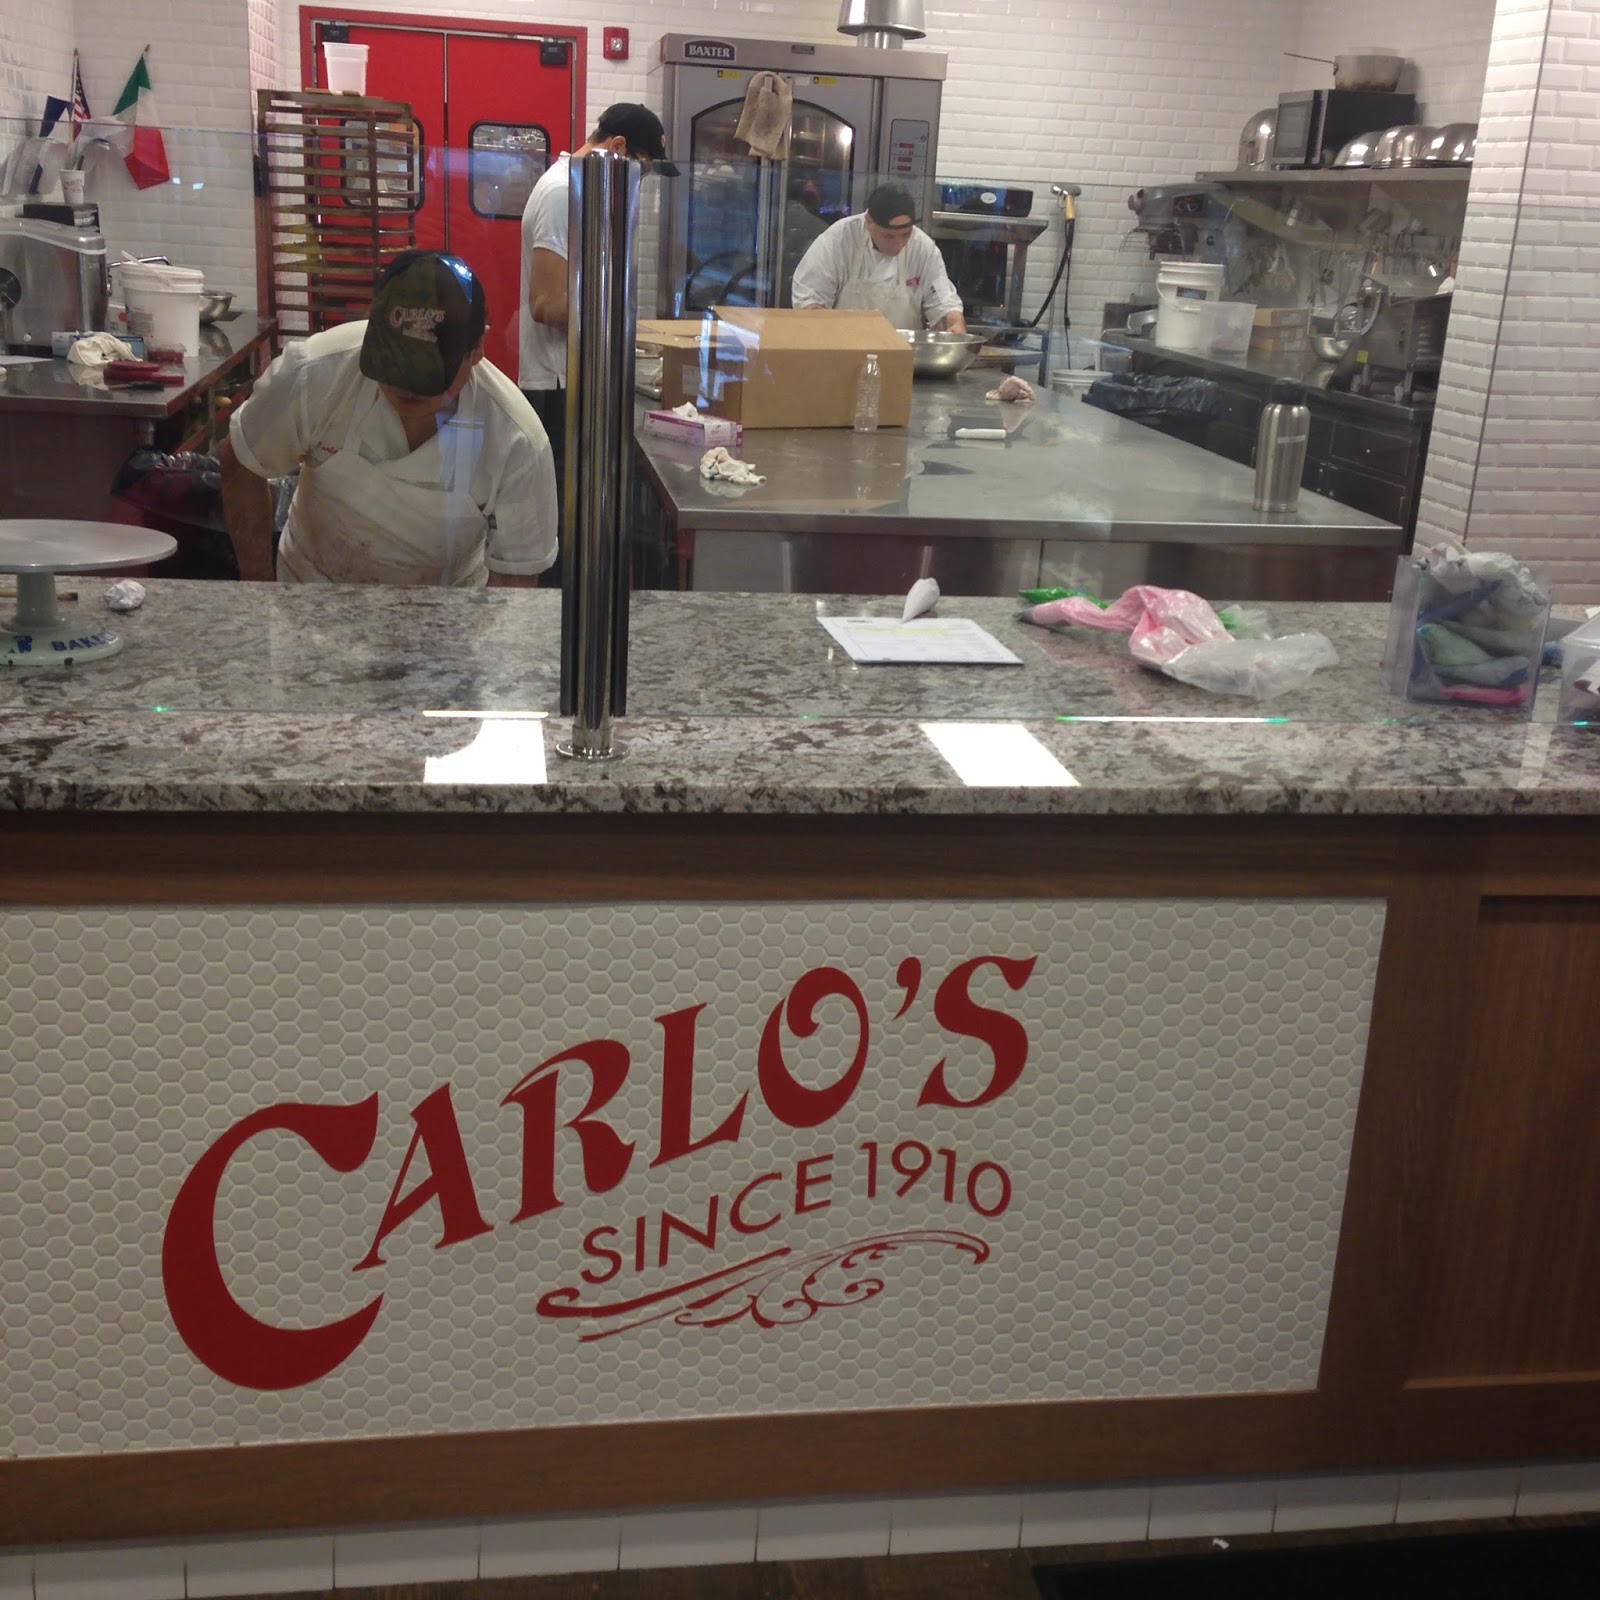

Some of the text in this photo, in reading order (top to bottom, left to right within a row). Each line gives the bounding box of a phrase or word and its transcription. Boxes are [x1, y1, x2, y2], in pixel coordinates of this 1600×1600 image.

[688, 46, 731, 58] BAXTER
[161, 956, 1036, 1391] CARLO'S
[581, 1140, 1011, 1284] SINCE 1910
